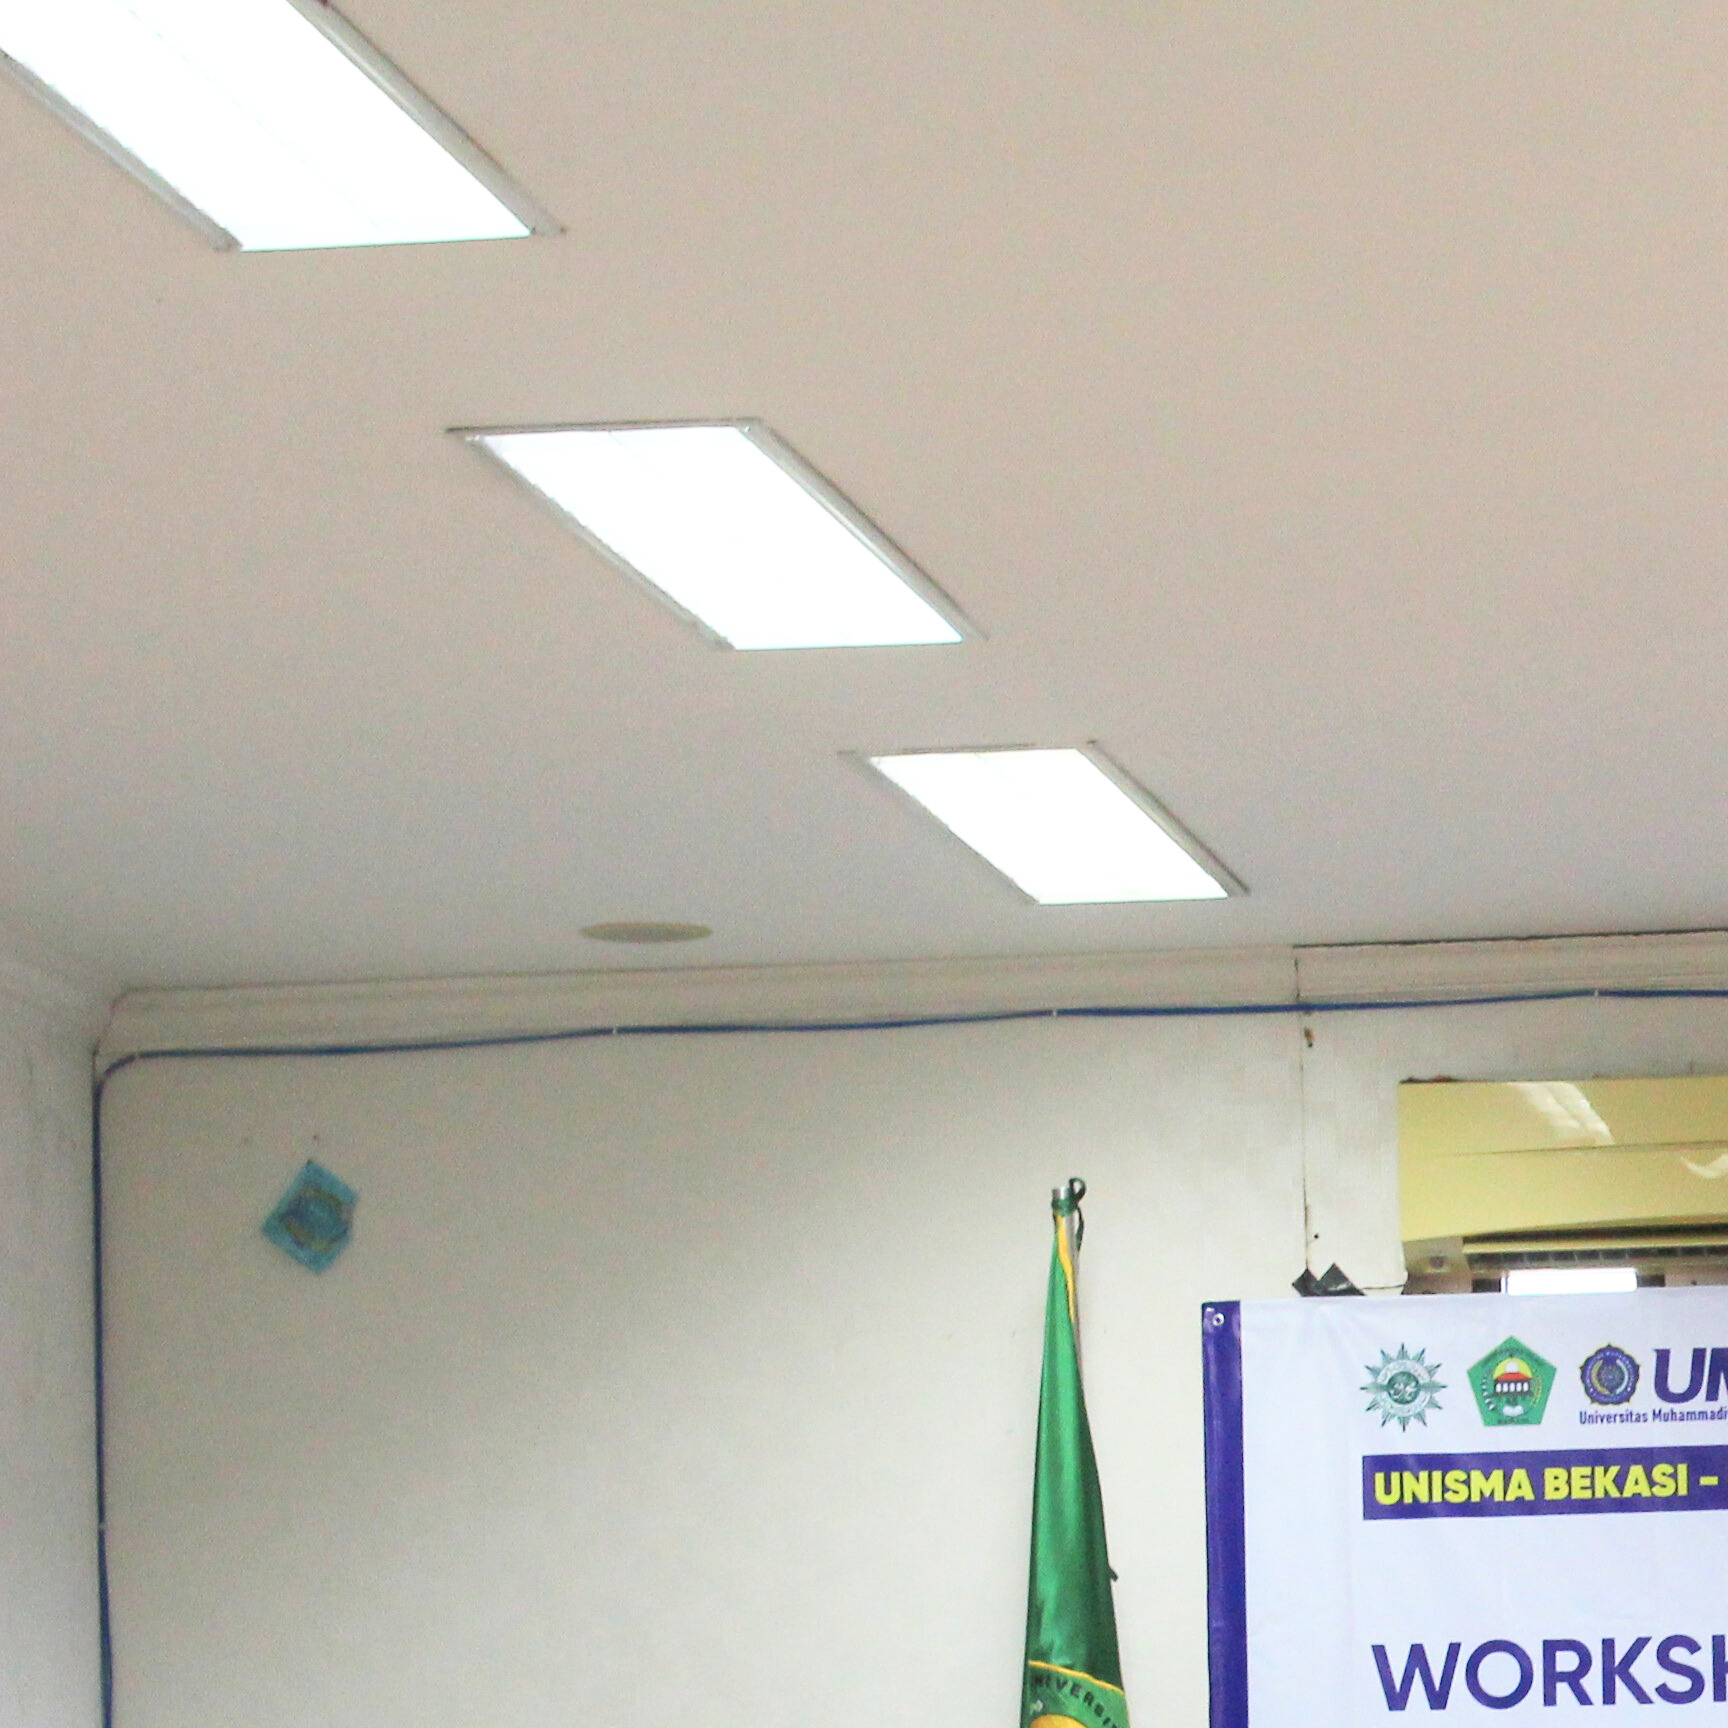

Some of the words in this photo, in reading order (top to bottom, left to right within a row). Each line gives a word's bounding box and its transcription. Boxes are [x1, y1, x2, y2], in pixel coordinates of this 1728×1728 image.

[1579, 1410, 1649, 1425] Universitas
[1375, 1466, 1534, 1507] UNISMA
[1544, 1463, 1688, 1500] BEKASI
